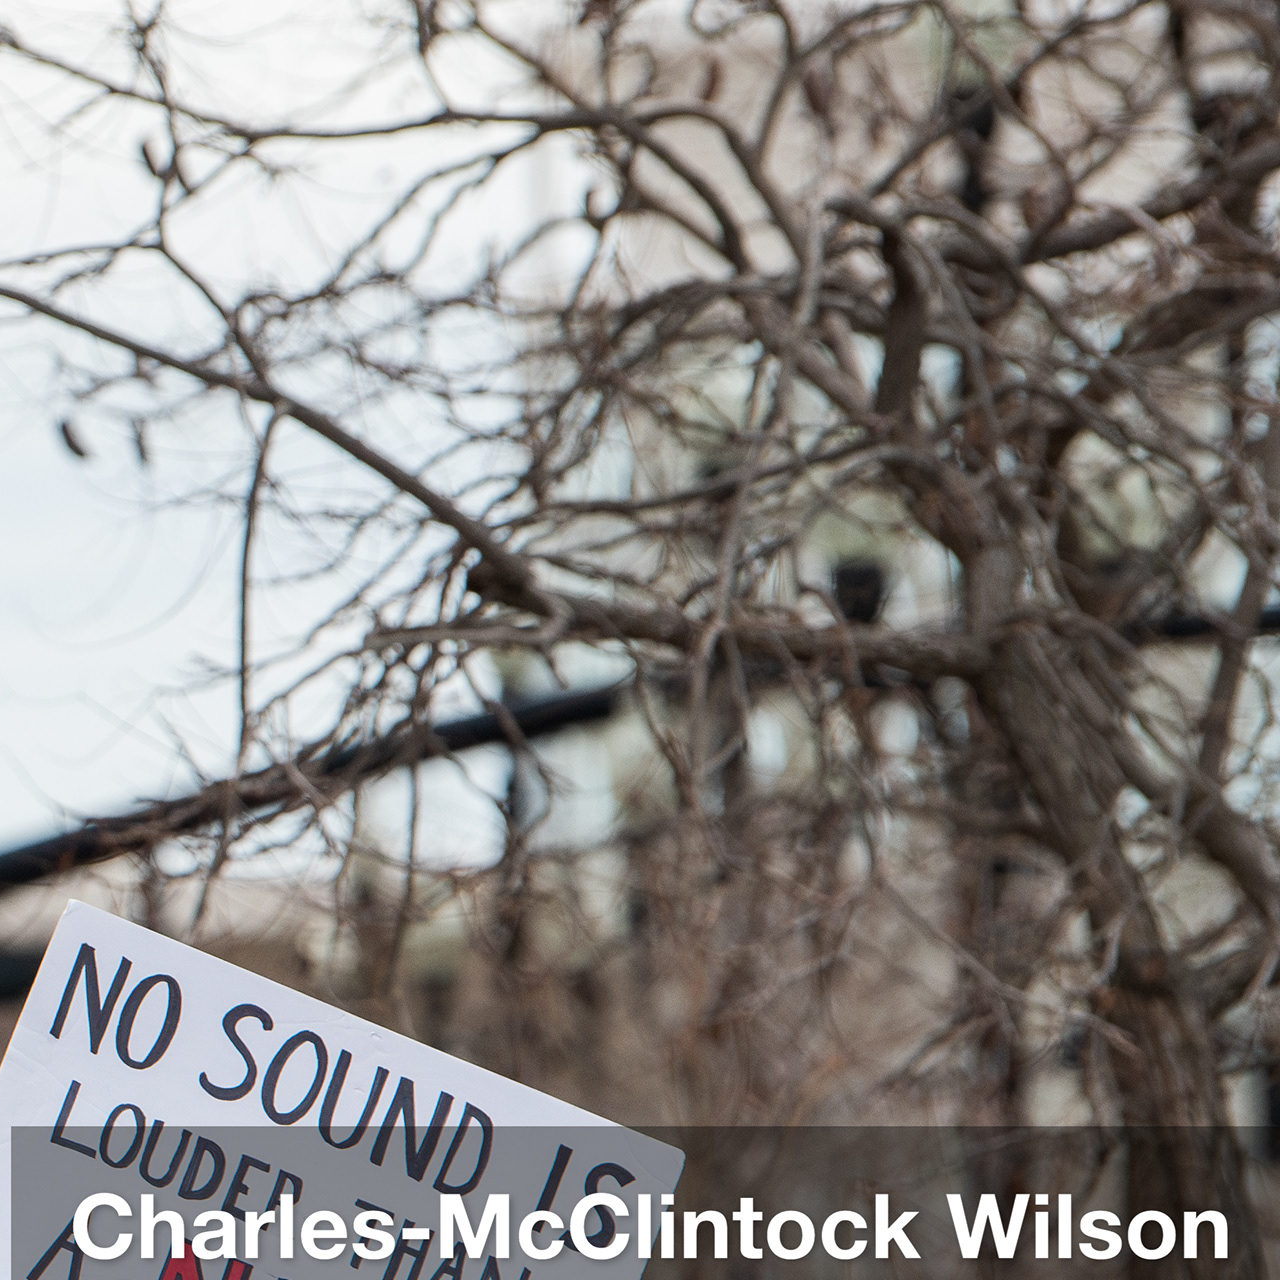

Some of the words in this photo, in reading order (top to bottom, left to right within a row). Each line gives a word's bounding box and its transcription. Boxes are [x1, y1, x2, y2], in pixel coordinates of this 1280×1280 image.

[50, 943, 182, 1069] NO
[199, 1003, 493, 1196] SOUND
[533, 1144, 636, 1252] IS
[50, 1080, 303, 1231] LOUDER
